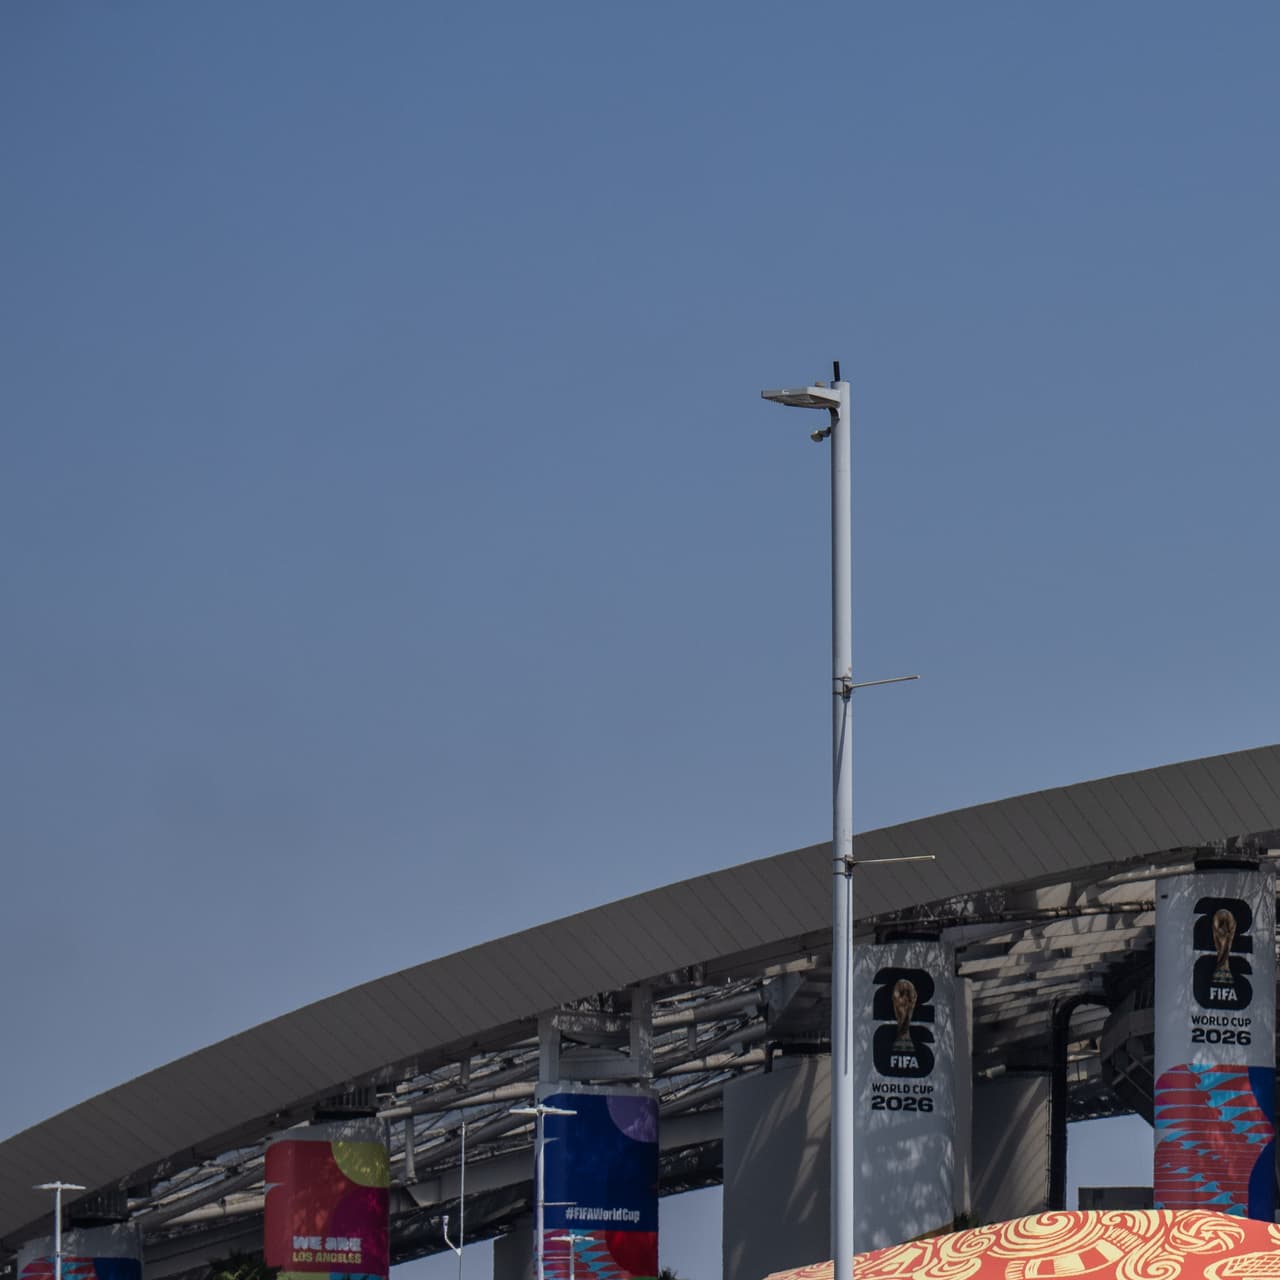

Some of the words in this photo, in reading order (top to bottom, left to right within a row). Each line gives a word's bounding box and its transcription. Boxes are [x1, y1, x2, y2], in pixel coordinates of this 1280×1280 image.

[1209, 987, 1238, 1001] FIFA
[1191, 1015, 1229, 1026] WORLD
[1231, 1016, 1251, 1027] CUP
[1191, 1028, 1251, 1045] 2026
[890, 1056, 919, 1069] FIFA
[872, 1083, 911, 1094] WORLD
[913, 1084, 934, 1095] CUP
[872, 1095, 934, 1112] 2026
[565, 1207, 639, 1223] #FIFAWorldCup
[293, 1235, 322, 1250] WE
[325, 1237, 362, 1252] ARE
[292, 1251, 312, 1263] LOS
[315, 1252, 361, 1264] ANGELES
